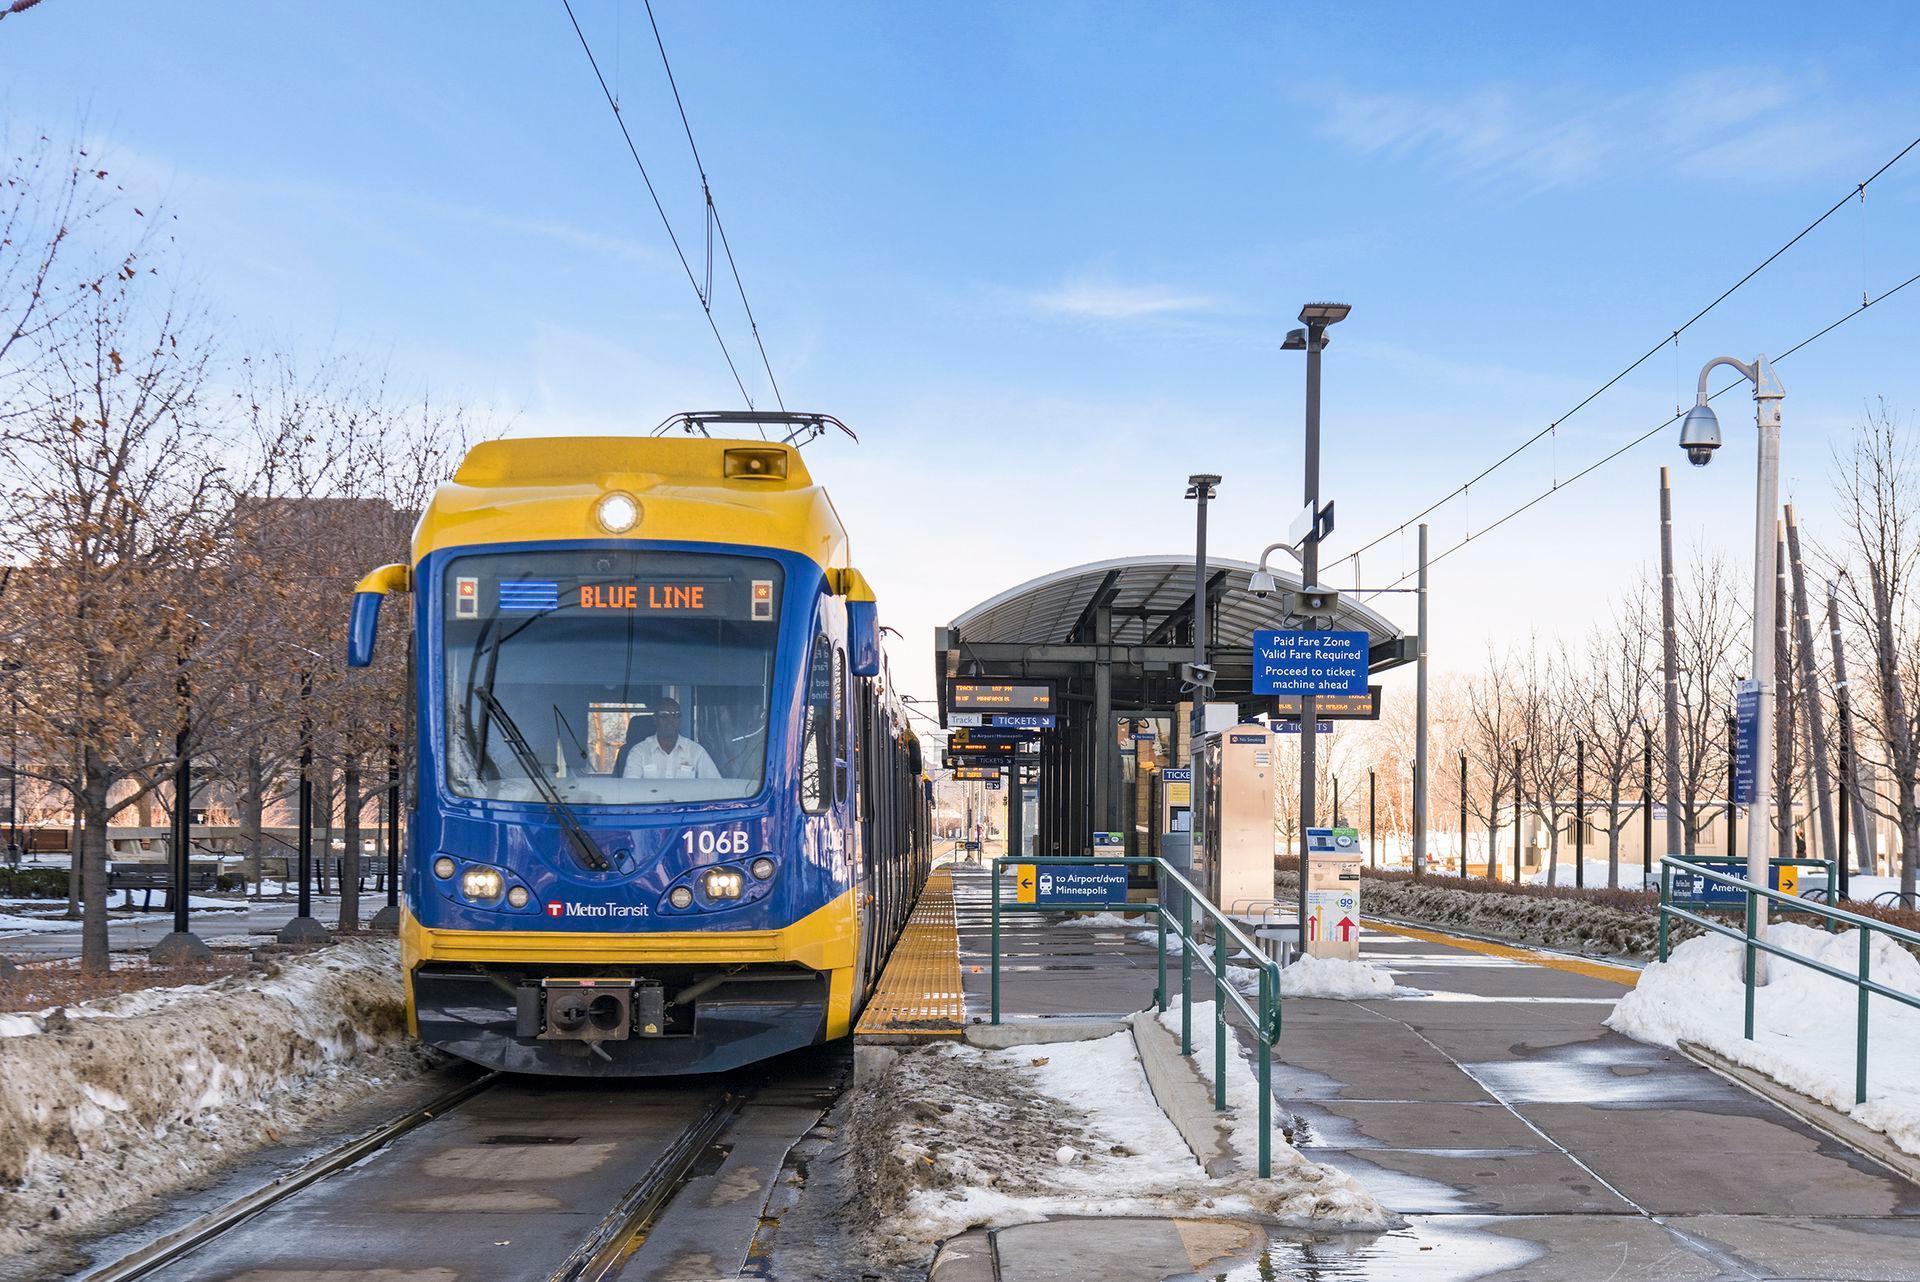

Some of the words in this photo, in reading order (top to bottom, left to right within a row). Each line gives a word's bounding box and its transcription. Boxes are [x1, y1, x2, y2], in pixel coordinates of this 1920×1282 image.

[580, 586, 637, 608] BLUE
[649, 586, 704, 608] LINE
[1273, 636, 1295, 647] Paid
[1298, 637, 1320, 647] Fare
[1323, 637, 1351, 647] Zone
[1261, 650, 1287, 659] Valid
[1289, 650, 1312, 659] Fare
[1315, 650, 1361, 662] Required
[1265, 666, 1308, 676] Proceed
[1311, 668, 1323, 676] to
[1326, 667, 1356, 677] ticket
[1272, 679, 1315, 689] machine
[1318, 680, 1349, 690] ahead
[951, 715, 973, 724] Track
[998, 716, 1037, 725] TICKETS
[682, 830, 750, 854] 106B
[1056, 875, 1066, 883] to
[1067, 874, 1125, 885] Airport/dwtn
[1056, 886, 1108, 896] Minneapolis
[1340, 897, 1353, 907] go
